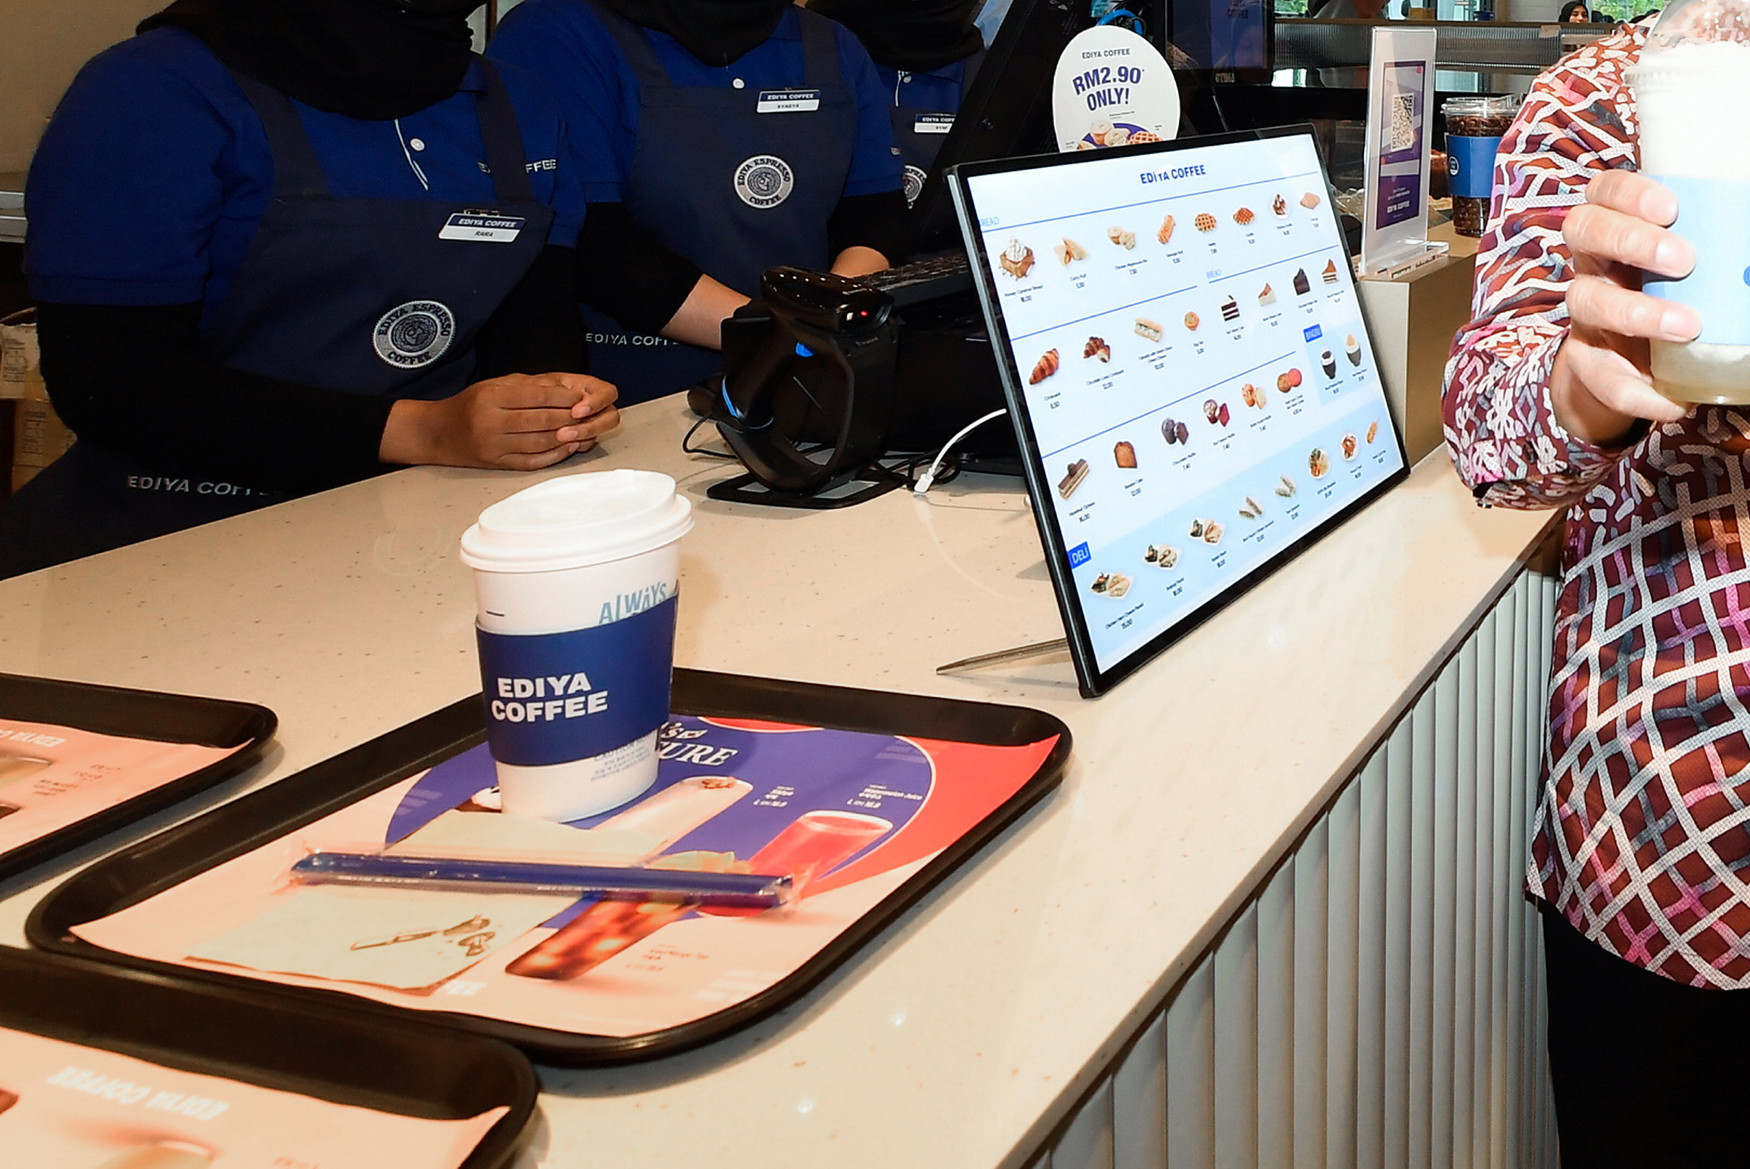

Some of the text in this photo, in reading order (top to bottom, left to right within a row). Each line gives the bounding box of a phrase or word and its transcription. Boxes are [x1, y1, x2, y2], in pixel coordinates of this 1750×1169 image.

[1082, 48, 1130, 59] EDIYA COFFEE
[1072, 66, 1142, 95] RM2.90
[1086, 87, 1129, 111] ONLY!
[525, 159, 557, 173] FFEE
[738, 158, 791, 186] EDIYA ESPRESSO
[1171, 164, 1206, 180] COFFEE
[750, 195, 782, 206] COFFEE
[458, 218, 517, 228] EDIYA COFFEE
[378, 308, 408, 336] EDIYA
[586, 333, 628, 345] EDIYA
[388, 351, 432, 365] COFFEE
[127, 475, 190, 492] EDIYA
[1072, 547, 1089, 564] DELI
[498, 672, 592, 699] EDIYA
[491, 691, 608, 723] COFFEE
